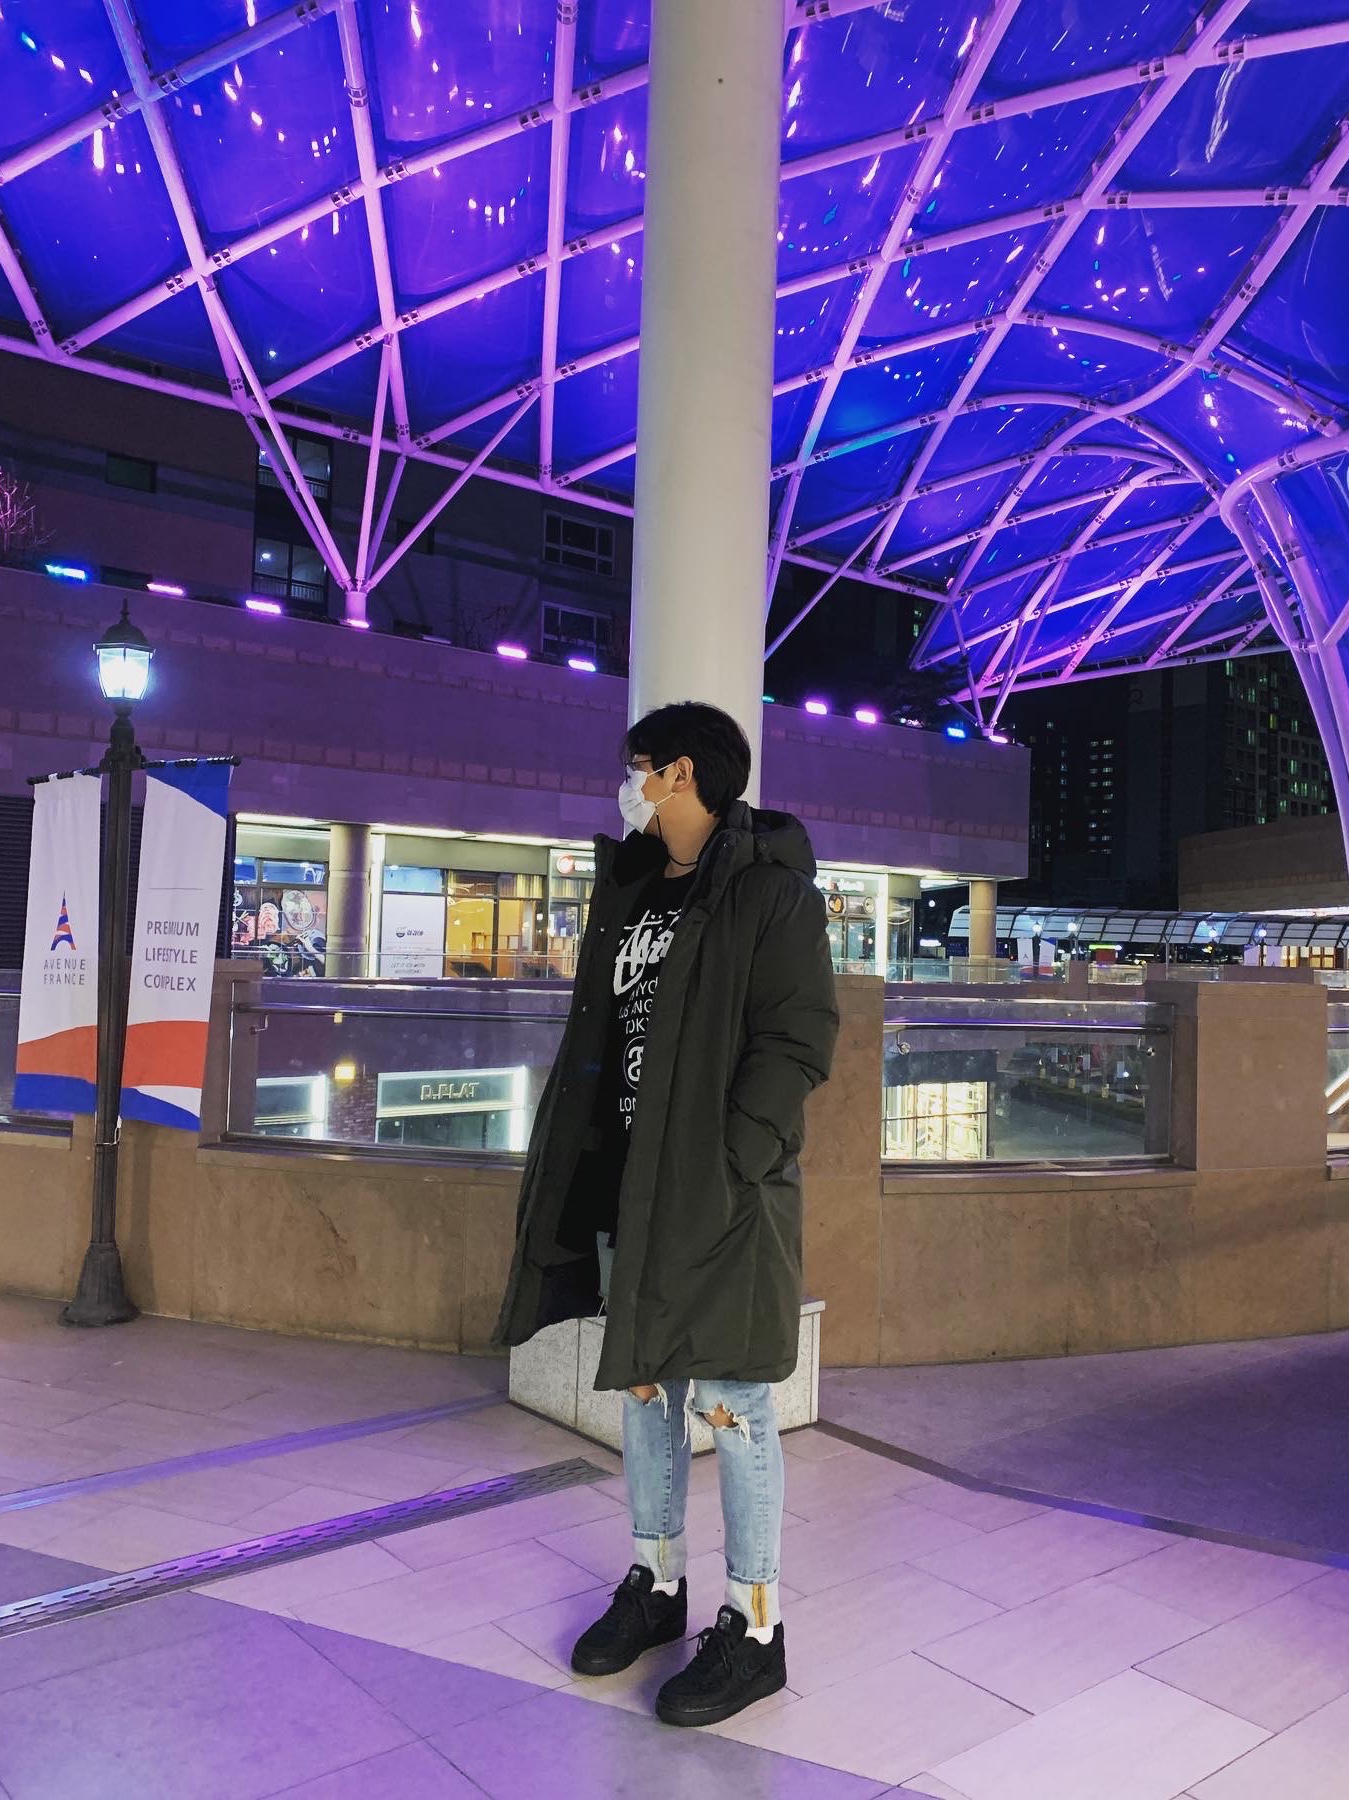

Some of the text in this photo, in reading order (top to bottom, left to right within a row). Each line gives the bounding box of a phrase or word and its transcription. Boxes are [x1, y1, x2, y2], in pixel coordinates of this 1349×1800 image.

[146, 920, 200, 937] PREMIUM
[43, 958, 86, 970] AVENUE
[145, 947, 198, 964] LIFESTYLE
[43, 973, 85, 985] FRANCE
[143, 974, 197, 992] COMPLEX
